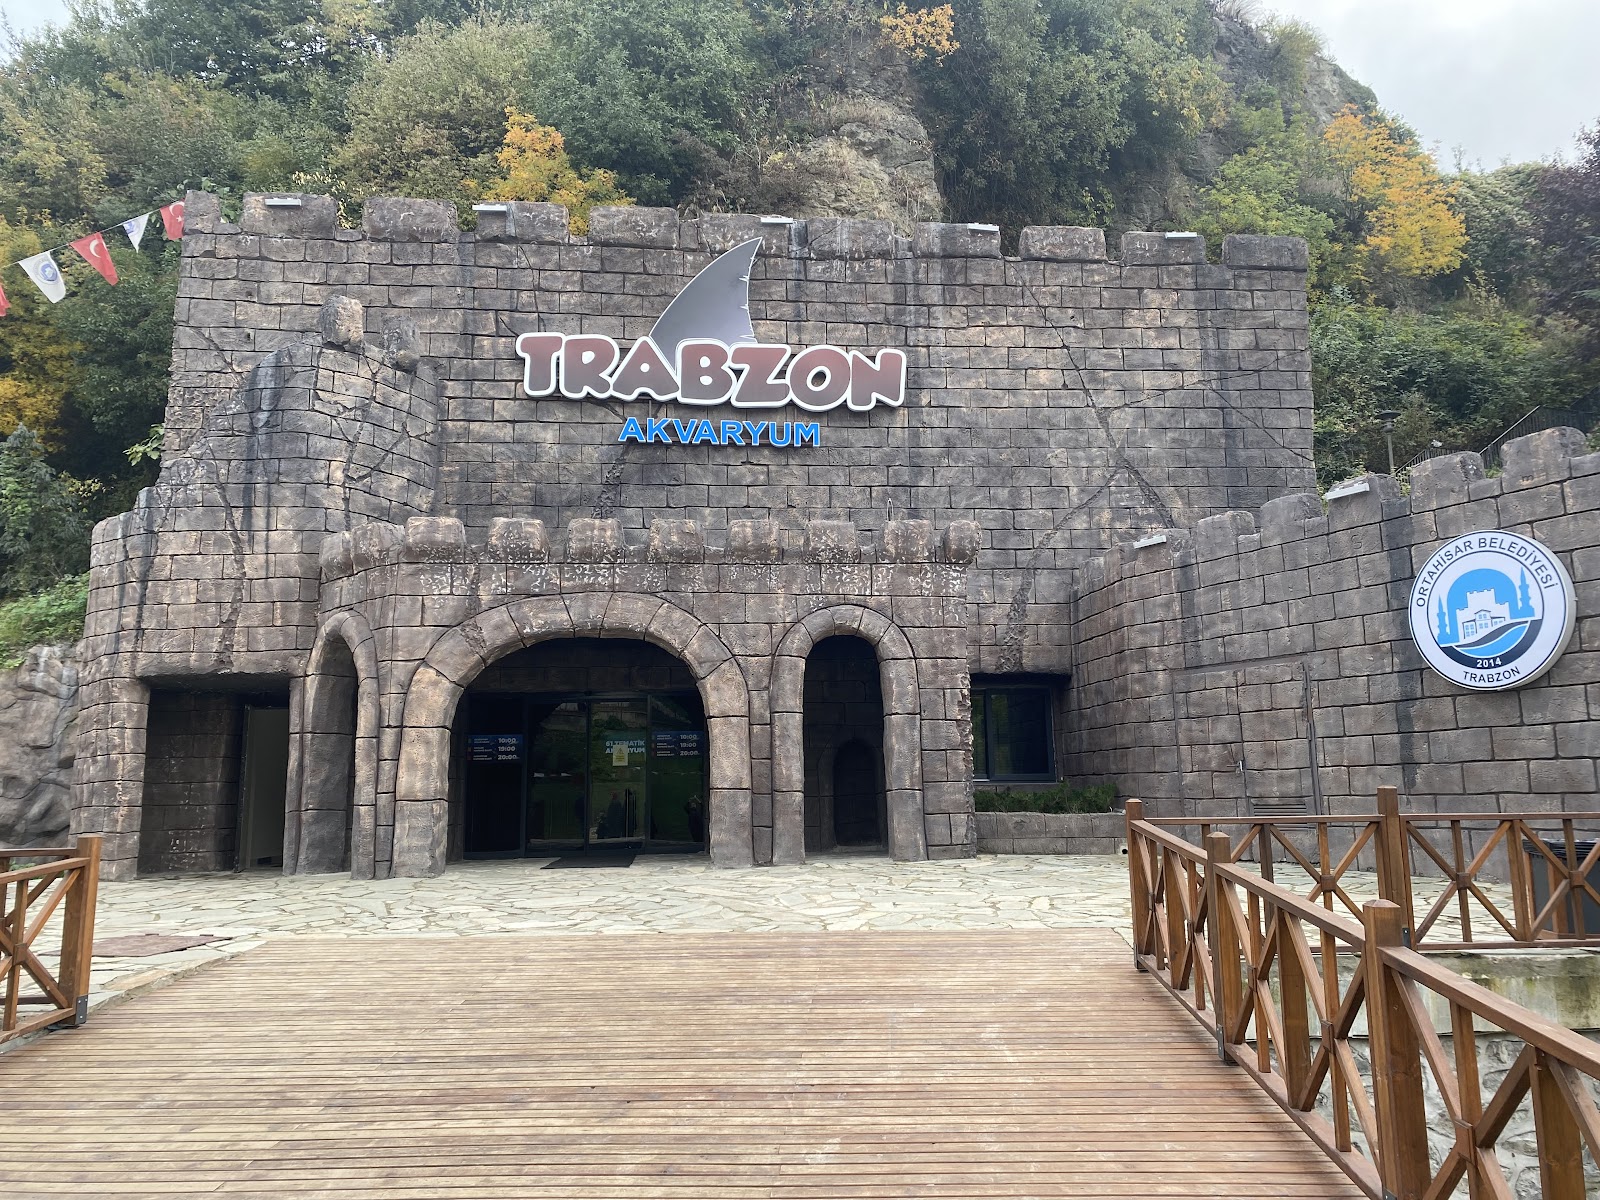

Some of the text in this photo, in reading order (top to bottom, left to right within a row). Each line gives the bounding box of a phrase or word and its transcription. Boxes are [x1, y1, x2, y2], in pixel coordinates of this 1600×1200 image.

[516, 332, 906, 412] TRABZON
[618, 417, 821, 447] AKVARYUM
[1416, 537, 1559, 607] ORTAHİSAR BELEDİYESİ
[1463, 666, 1521, 683] TRABZON
[1476, 657, 1502, 668] 2014
